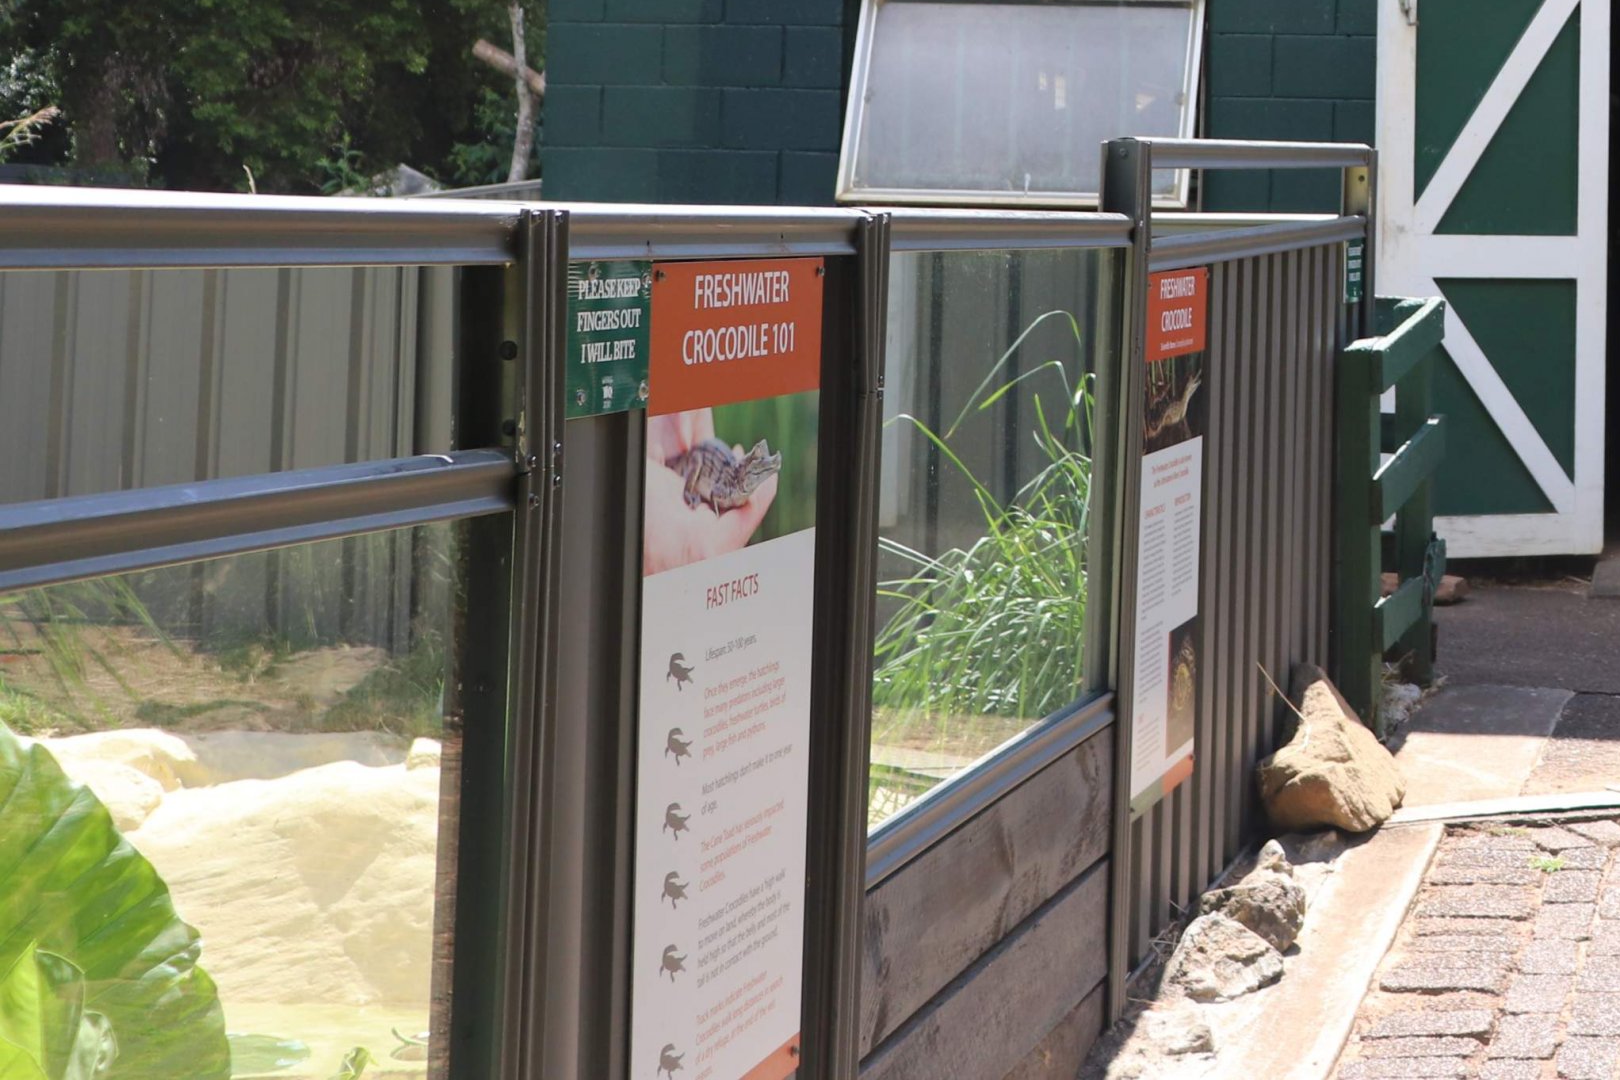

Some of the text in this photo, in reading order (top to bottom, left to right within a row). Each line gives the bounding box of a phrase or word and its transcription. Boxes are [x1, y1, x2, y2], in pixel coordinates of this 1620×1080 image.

[578, 278, 641, 300] PLEASE KEEP
[694, 271, 790, 308] FRESHWATER
[1160, 275, 1196, 300] FRESHWATER
[577, 308, 642, 332] FINGERS OUT
[1161, 307, 1193, 332] CROCODILE
[581, 339, 636, 364] I WILL BITE
[682, 322, 796, 365] CROCODILE 101
[707, 572, 759, 609] FAST FACTS
